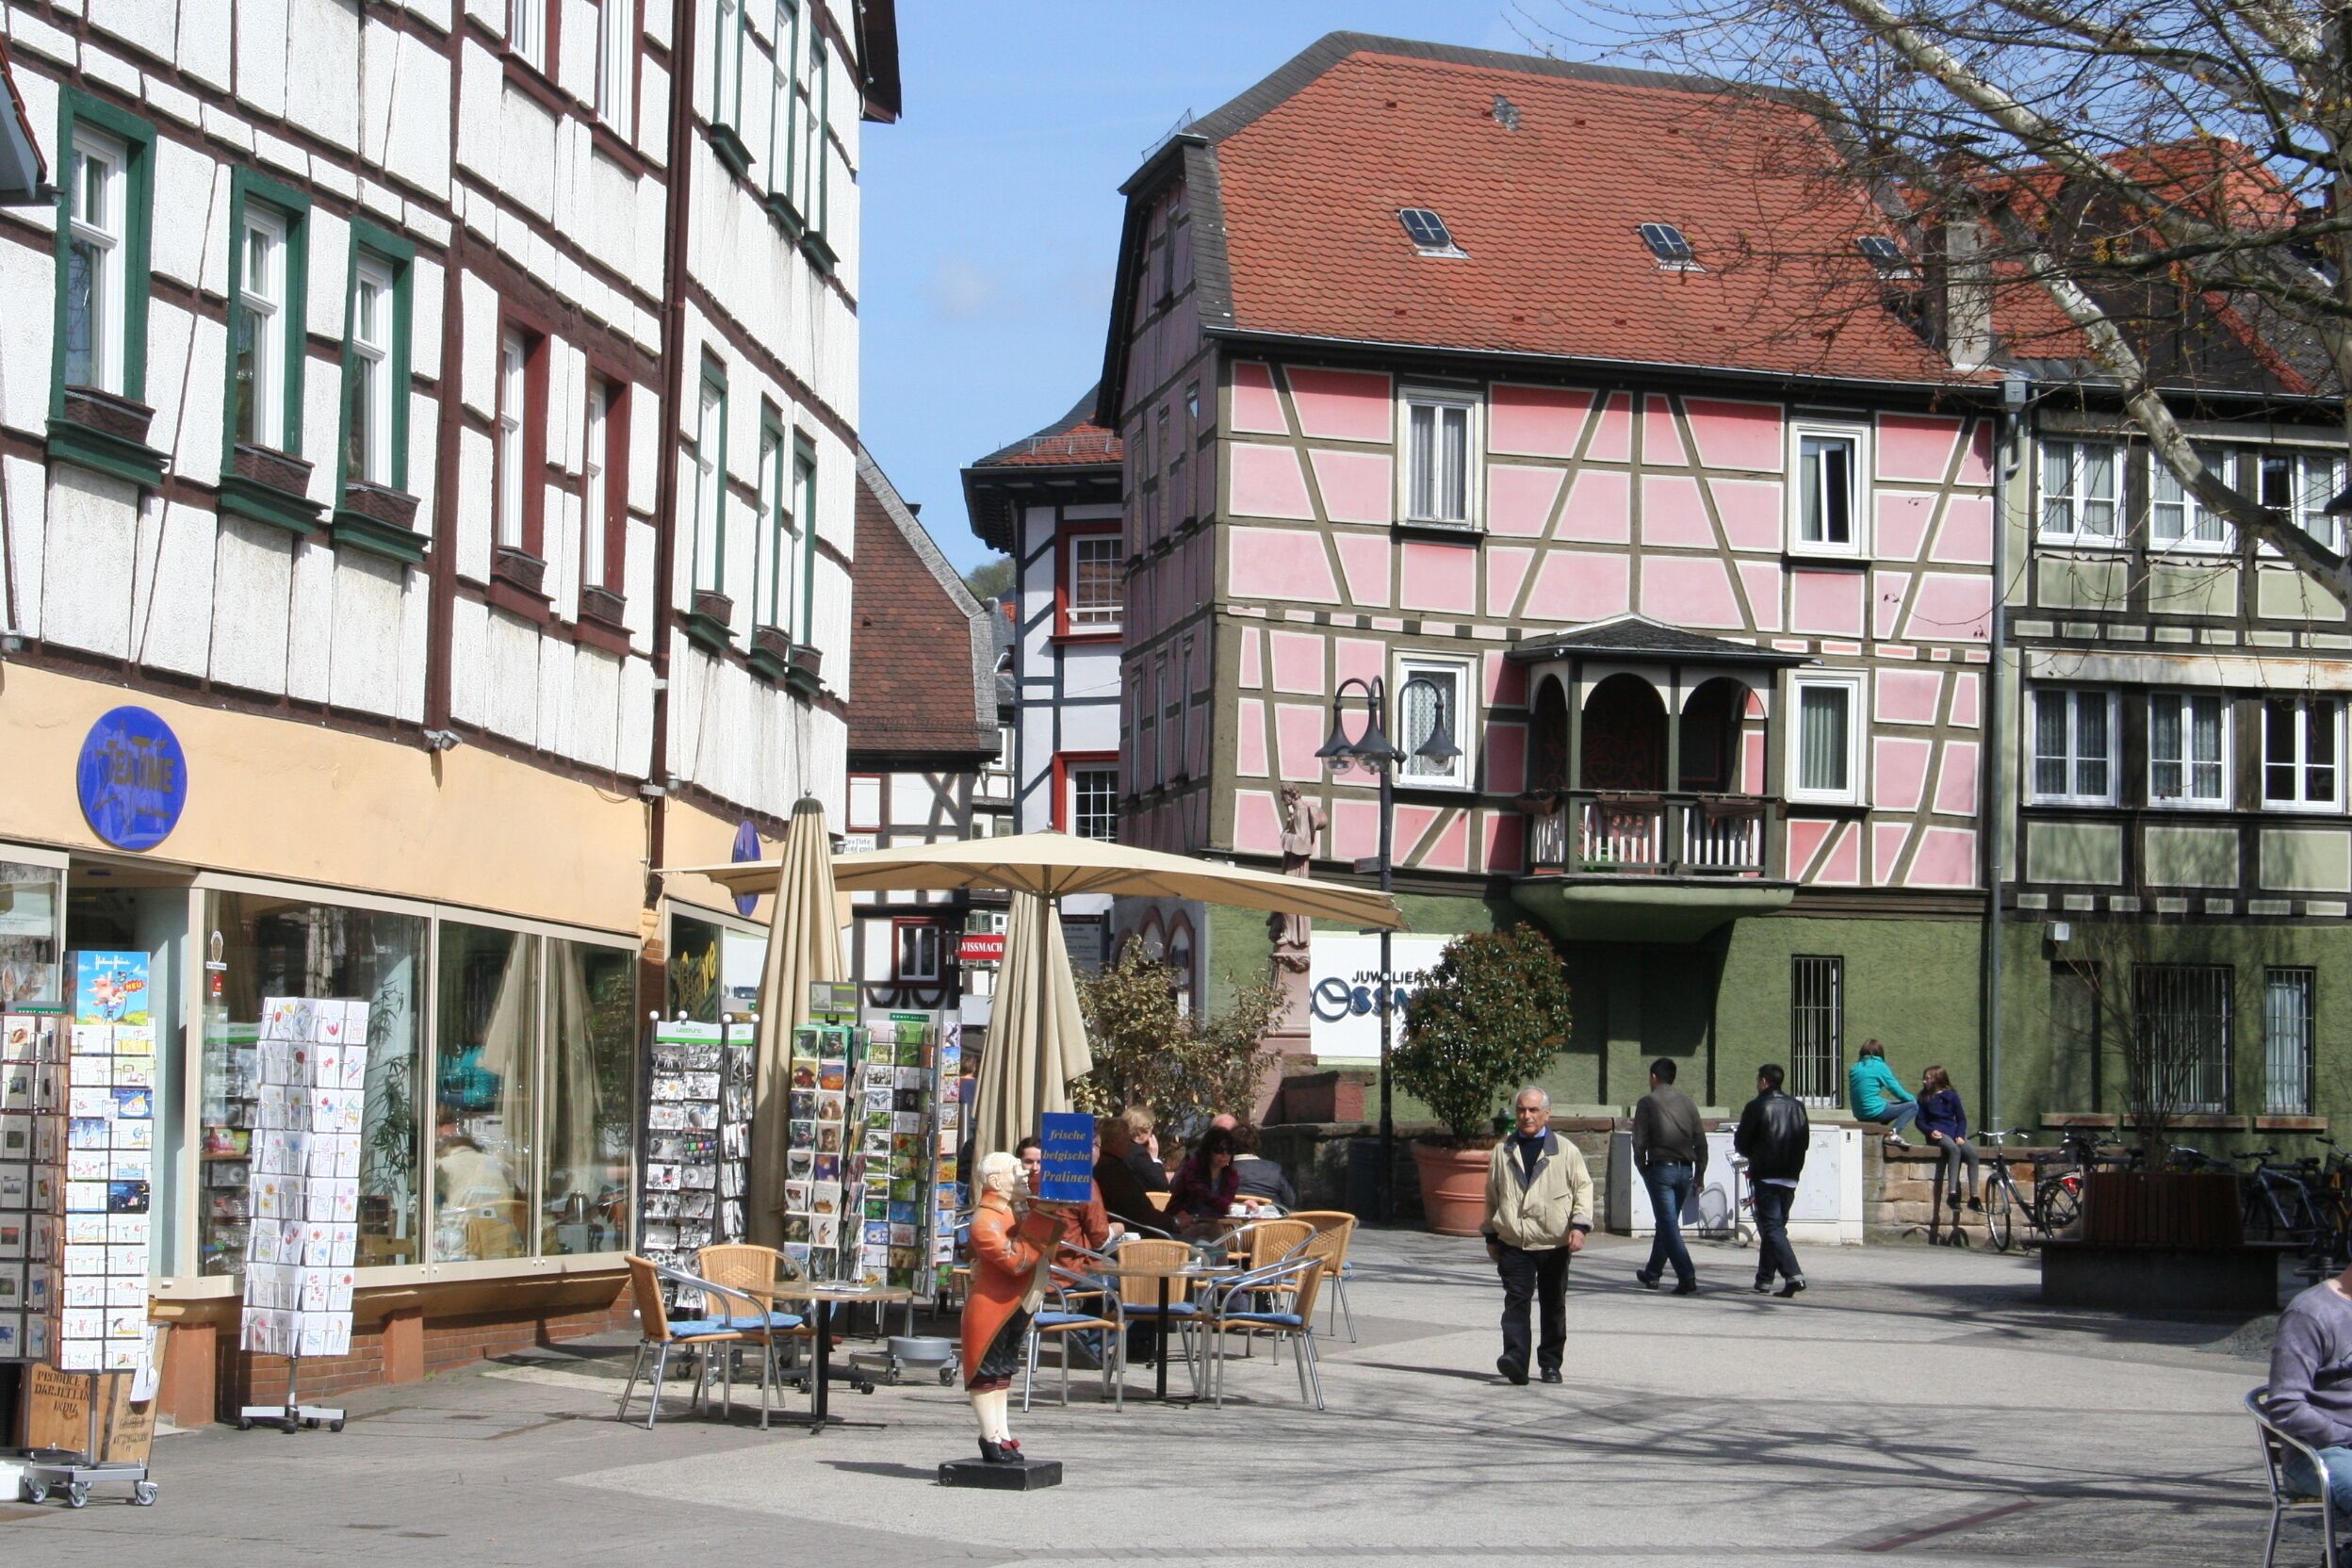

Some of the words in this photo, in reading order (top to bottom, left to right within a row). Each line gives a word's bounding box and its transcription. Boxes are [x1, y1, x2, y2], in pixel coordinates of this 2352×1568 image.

[125, 981, 142, 990] NEU
[1048, 1130, 1086, 1141] frische
[1042, 1150, 1090, 1162] belgische
[1042, 1169, 1090, 1183] Pralinen
[38, 1371, 81, 1387] PRODUCE
[35, 1383, 91, 1402] DARJEELIN
[53, 1400, 79, 1414] INDIA
